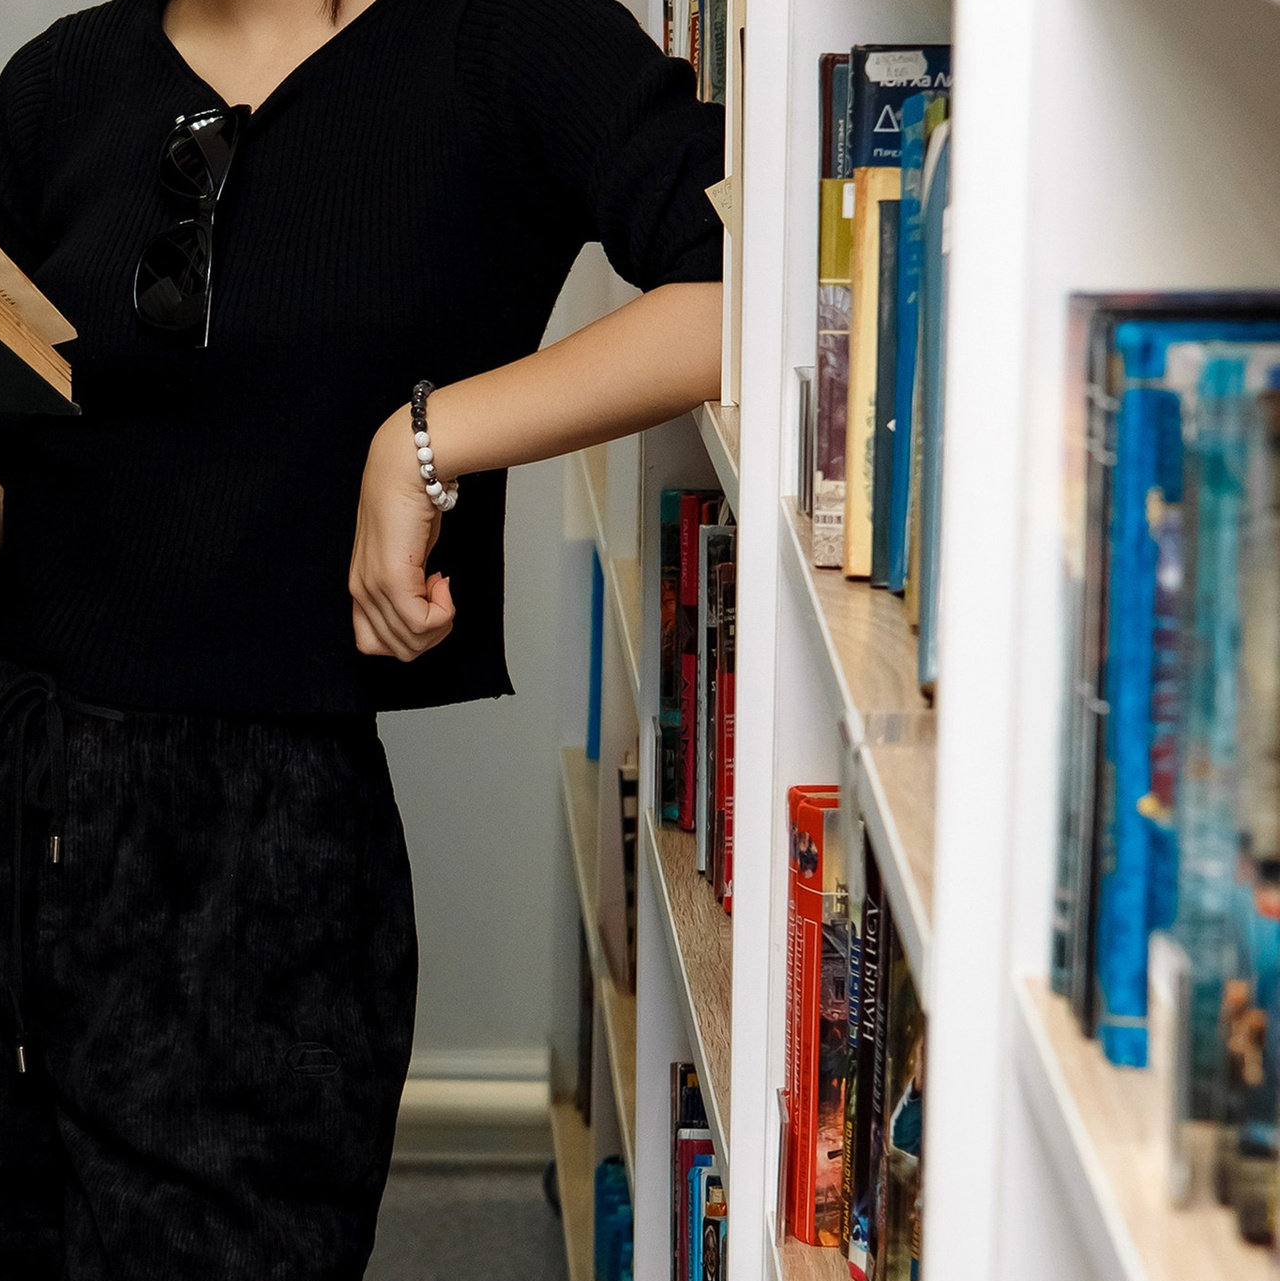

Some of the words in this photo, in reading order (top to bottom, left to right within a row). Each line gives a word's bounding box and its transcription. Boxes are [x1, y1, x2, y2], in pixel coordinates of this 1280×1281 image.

[864, 894, 879, 957] ДЭН
[862, 960, 878, 1043] БРАУН
[842, 1120, 853, 1194] ЗЛОТНИКОВ
[842, 1200, 851, 1244] РОМАН
